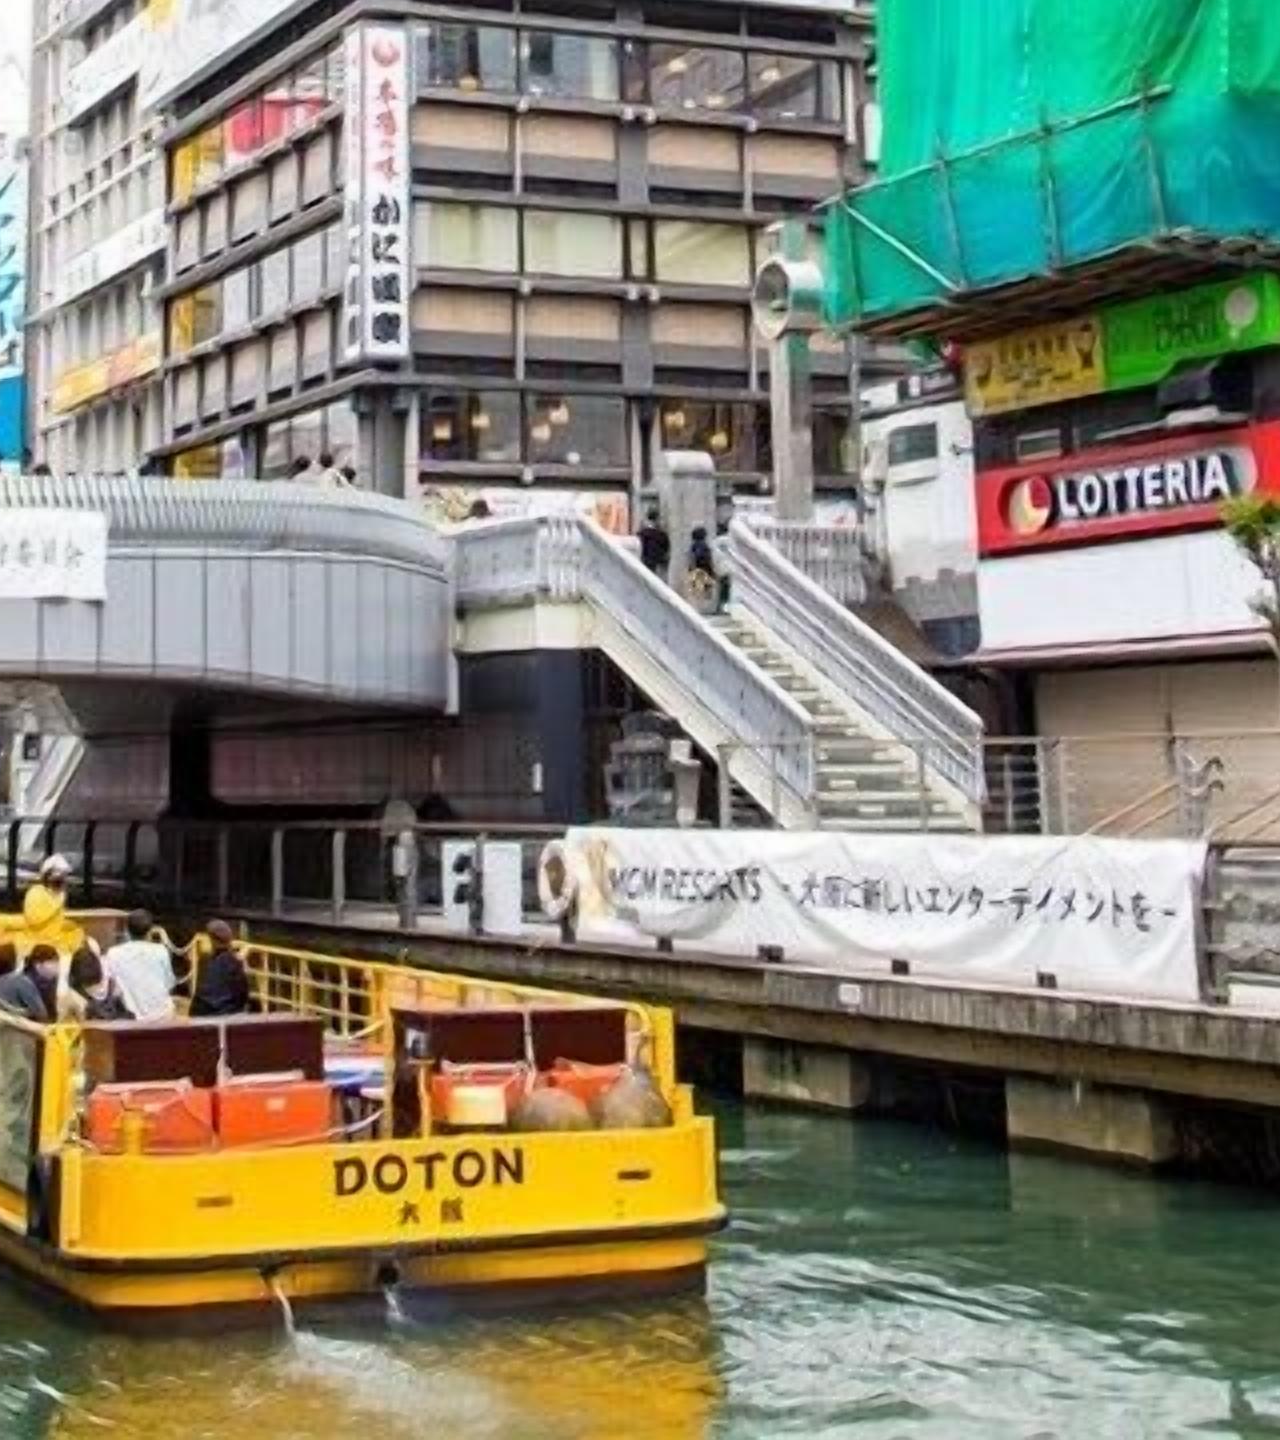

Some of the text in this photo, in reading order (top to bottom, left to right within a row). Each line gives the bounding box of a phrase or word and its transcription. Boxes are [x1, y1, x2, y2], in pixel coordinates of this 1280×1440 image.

[1054, 454, 1233, 519] LOTTERIA
[333, 1147, 525, 1197] DOTON
[399, 1196, 464, 1226] 大阪
